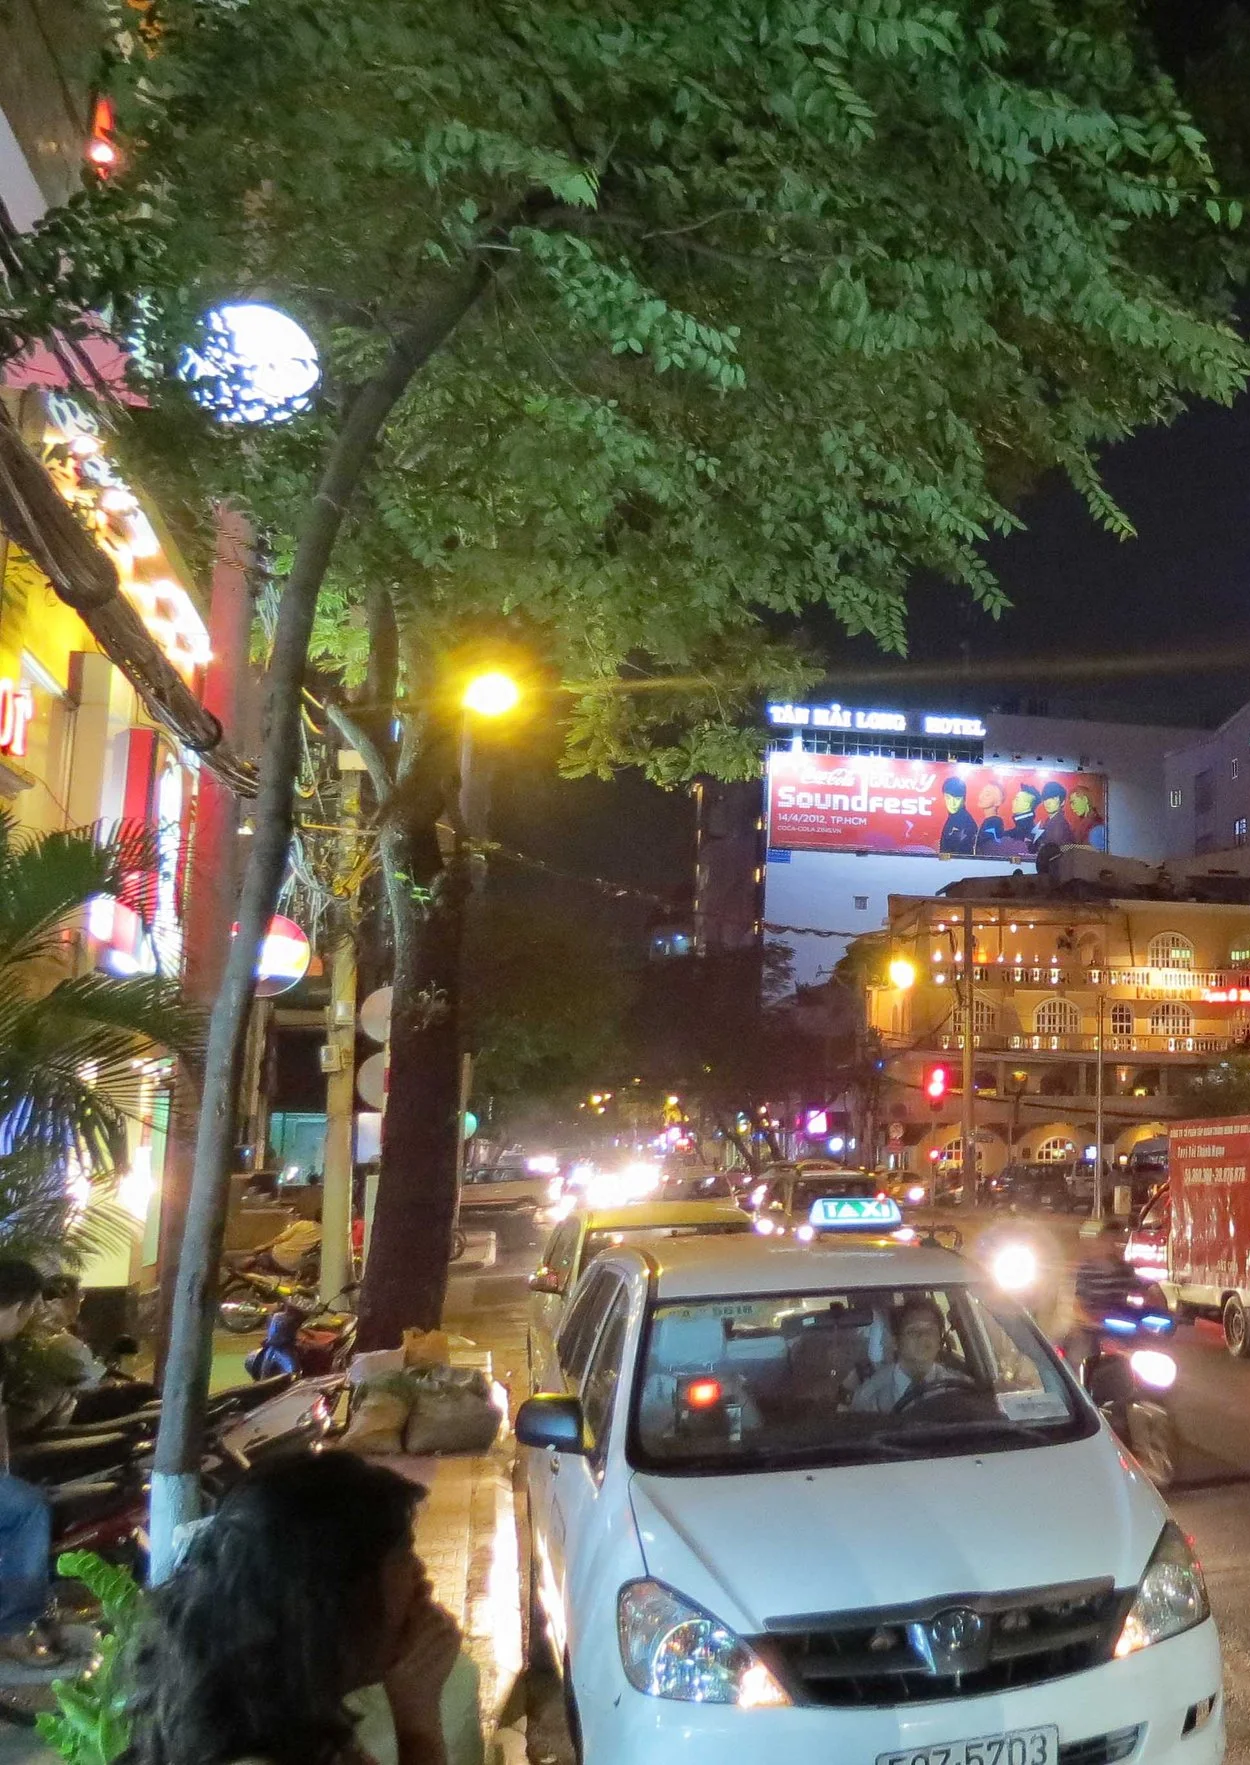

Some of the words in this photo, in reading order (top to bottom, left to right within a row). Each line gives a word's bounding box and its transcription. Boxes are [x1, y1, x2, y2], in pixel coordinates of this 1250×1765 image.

[856, 711, 906, 731] LONG
[925, 716, 986, 736] HOTEL
[778, 772, 934, 816] Soundfest
[823, 1200, 892, 1218] TAXI
